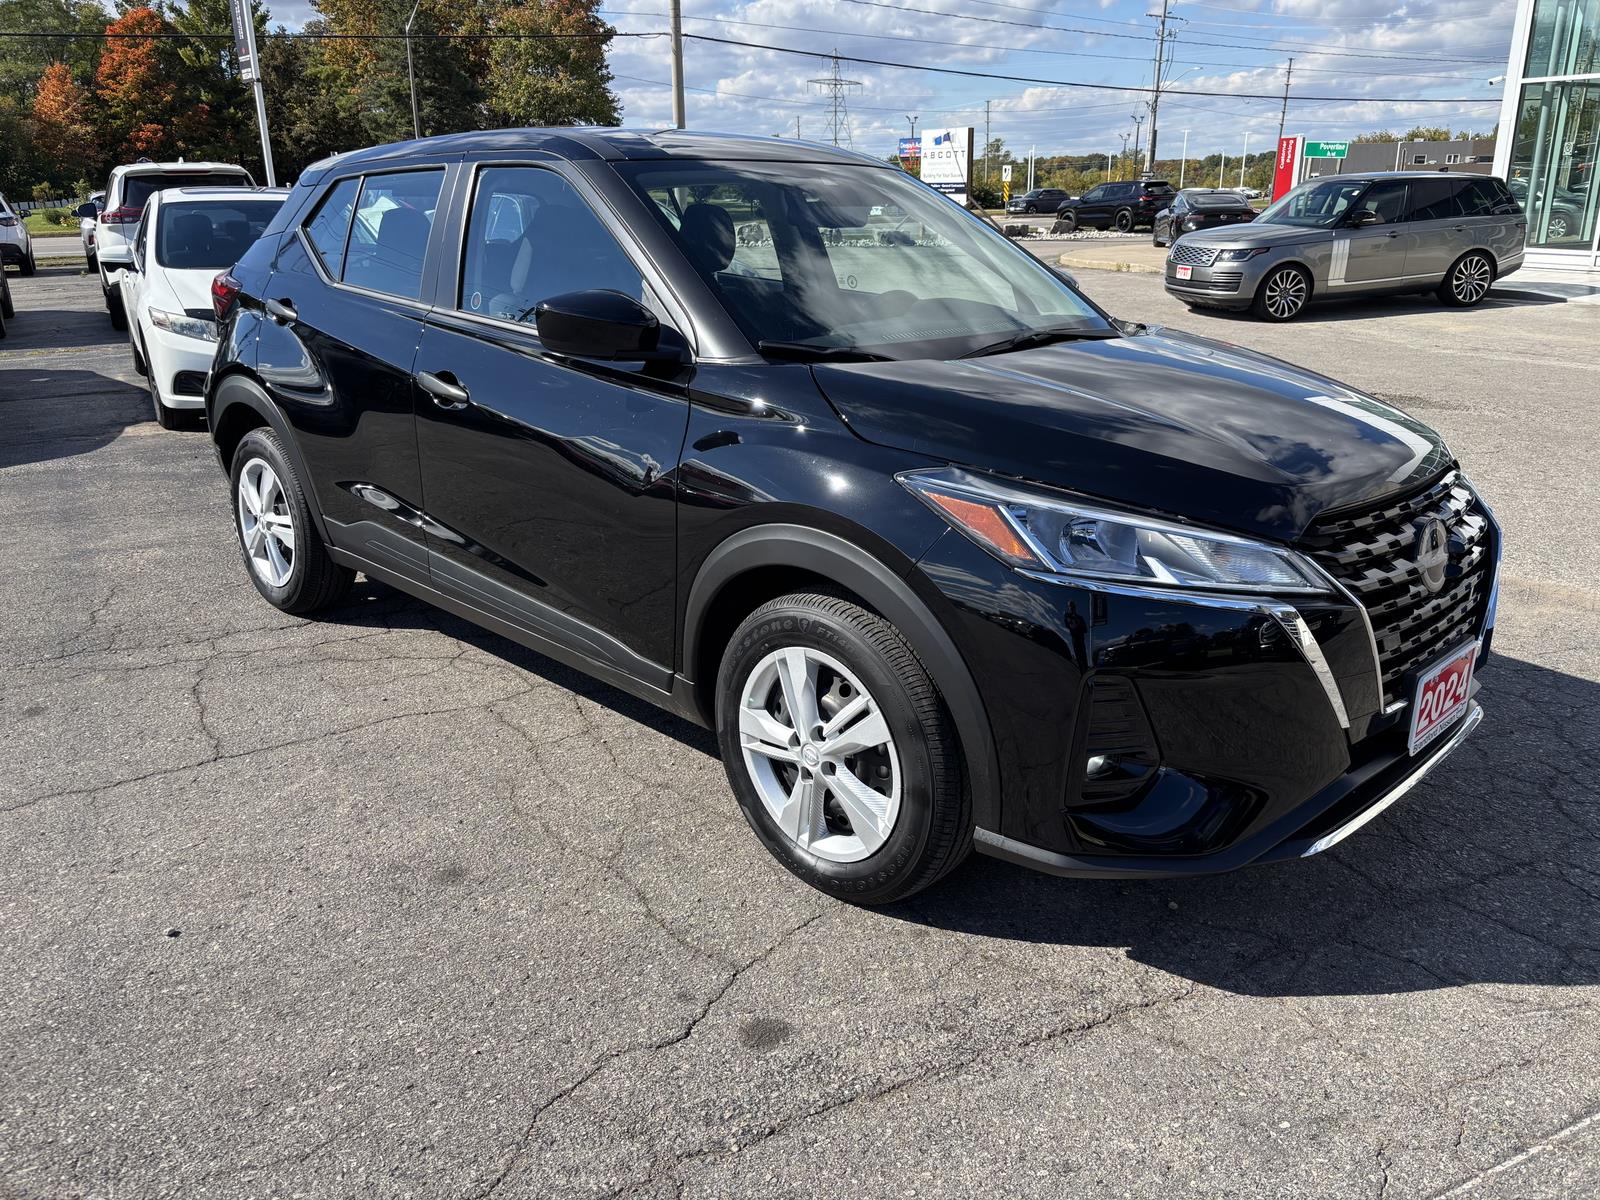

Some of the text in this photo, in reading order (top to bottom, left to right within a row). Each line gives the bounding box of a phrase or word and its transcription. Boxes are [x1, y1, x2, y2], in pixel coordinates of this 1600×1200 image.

[922, 150, 966, 159] ABCOTT
[1286, 139, 1294, 163] Parking
[1417, 663, 1469, 731] 2024
